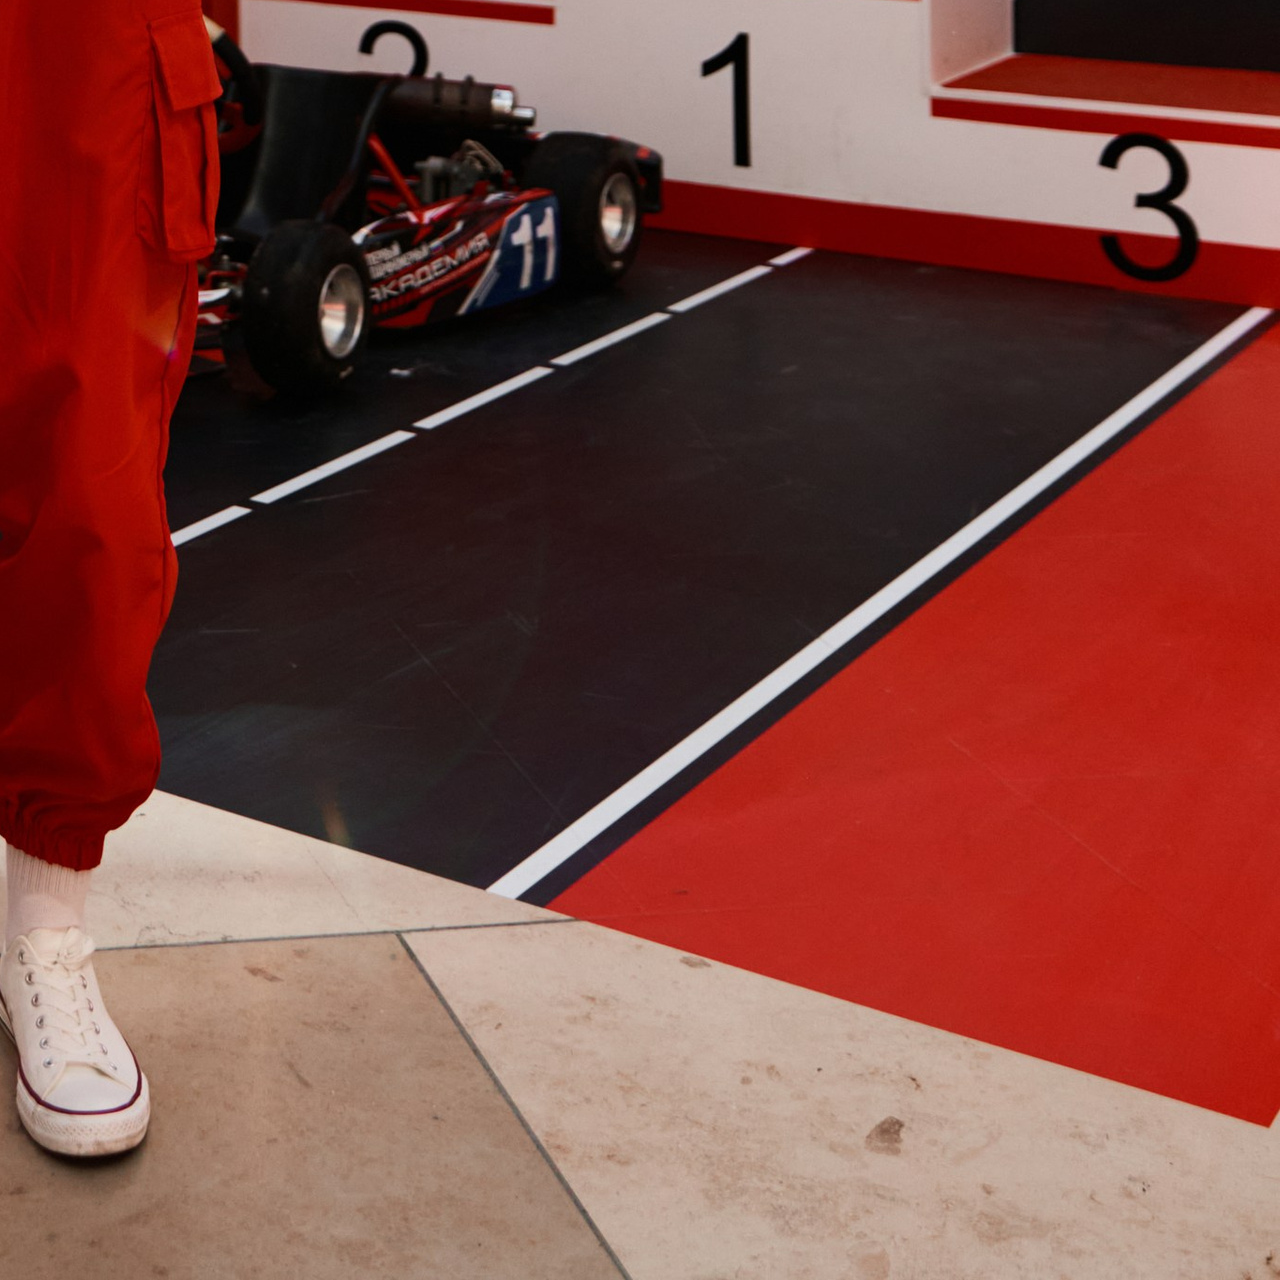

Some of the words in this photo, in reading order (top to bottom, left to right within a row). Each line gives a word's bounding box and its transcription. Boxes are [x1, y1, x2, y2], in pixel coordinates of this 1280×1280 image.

[701, 32, 751, 167] 1
[511, 206, 556, 289] 11
[1099, 132, 1199, 282] 3
